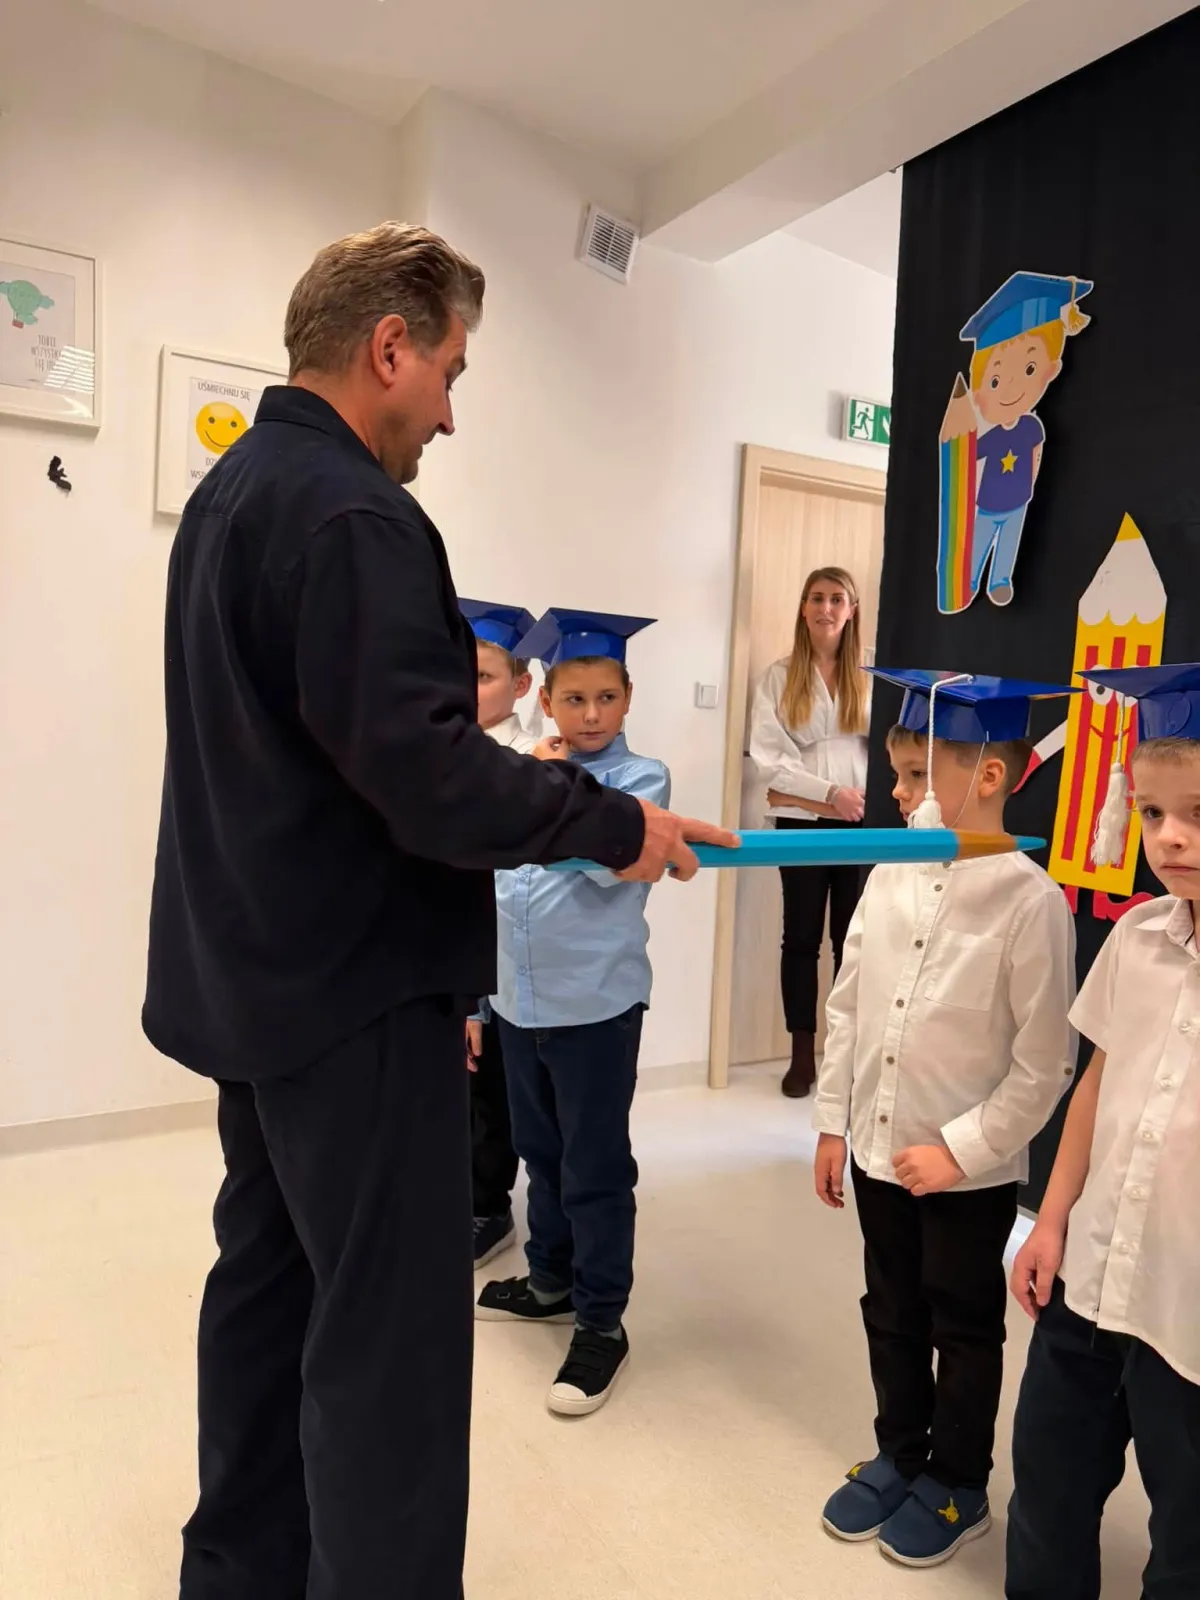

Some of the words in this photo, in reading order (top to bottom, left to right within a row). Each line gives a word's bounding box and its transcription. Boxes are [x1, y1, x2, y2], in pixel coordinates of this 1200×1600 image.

[198, 381, 239, 397] UŚMIECHNIJ
[240, 390, 250, 402] SIĘ
[205, 457, 215, 466] DZ
